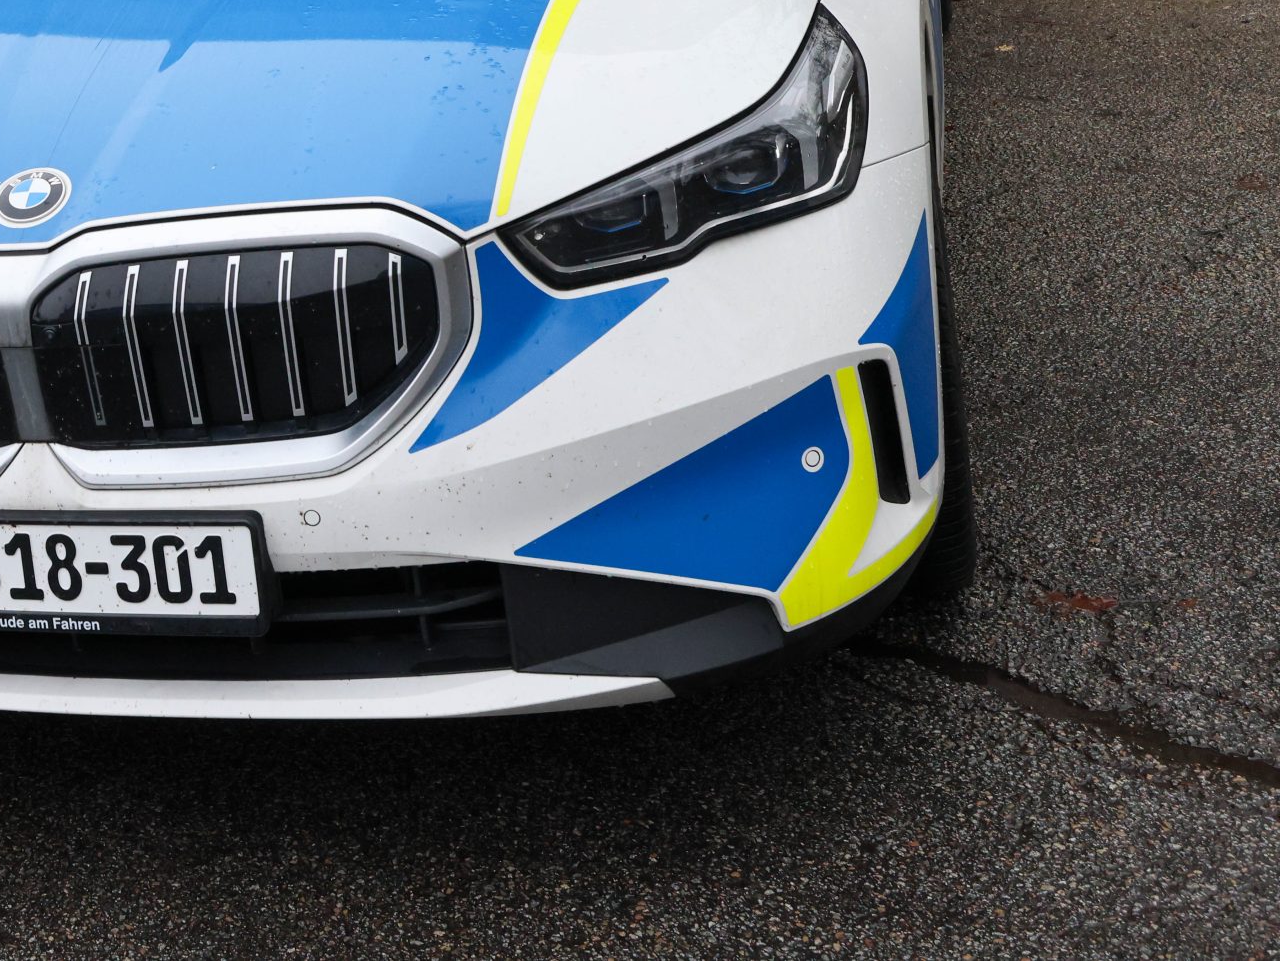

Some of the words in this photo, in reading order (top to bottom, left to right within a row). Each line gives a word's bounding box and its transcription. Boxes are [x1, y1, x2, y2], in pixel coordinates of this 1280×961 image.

[4, 532, 237, 605] 18-301
[28, 618, 49, 630] am
[52, 617, 101, 631] Fahren
